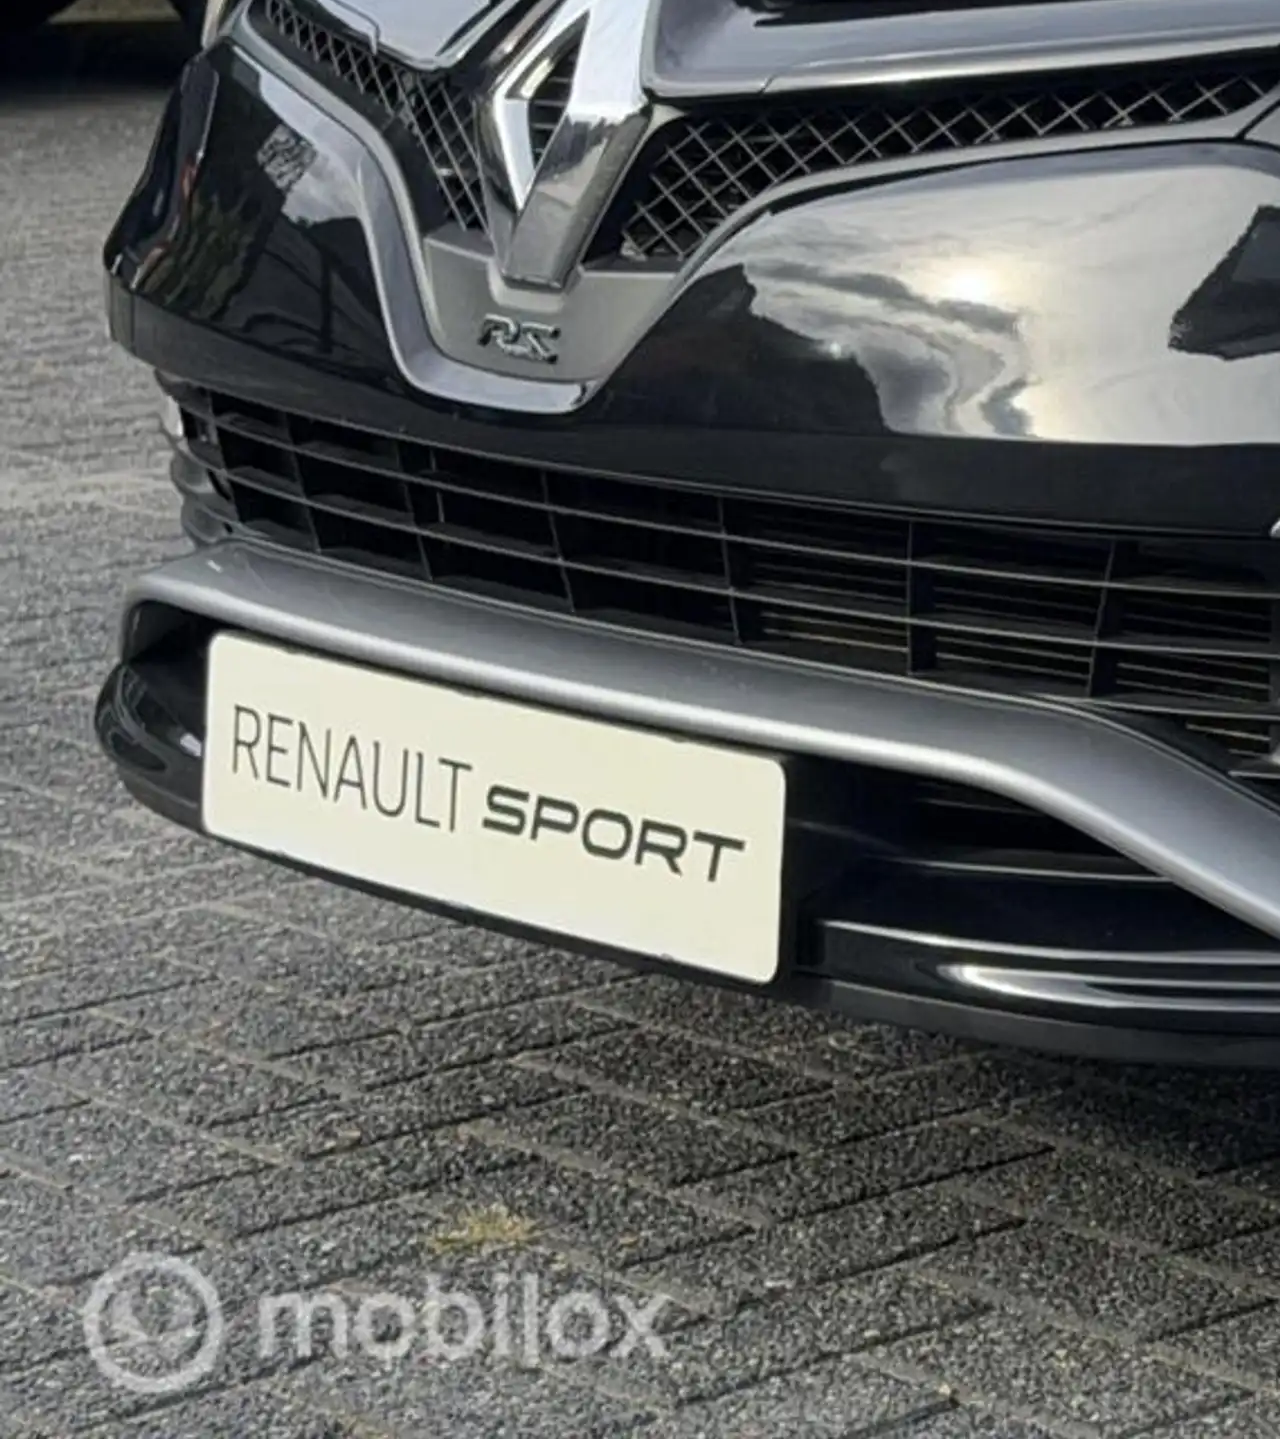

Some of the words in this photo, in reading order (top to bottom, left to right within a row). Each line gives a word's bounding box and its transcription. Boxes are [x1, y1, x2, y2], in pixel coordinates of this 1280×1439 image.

[479, 313, 561, 364] RS
[232, 703, 473, 832] RENAULT
[482, 784, 746, 883] SPORT
